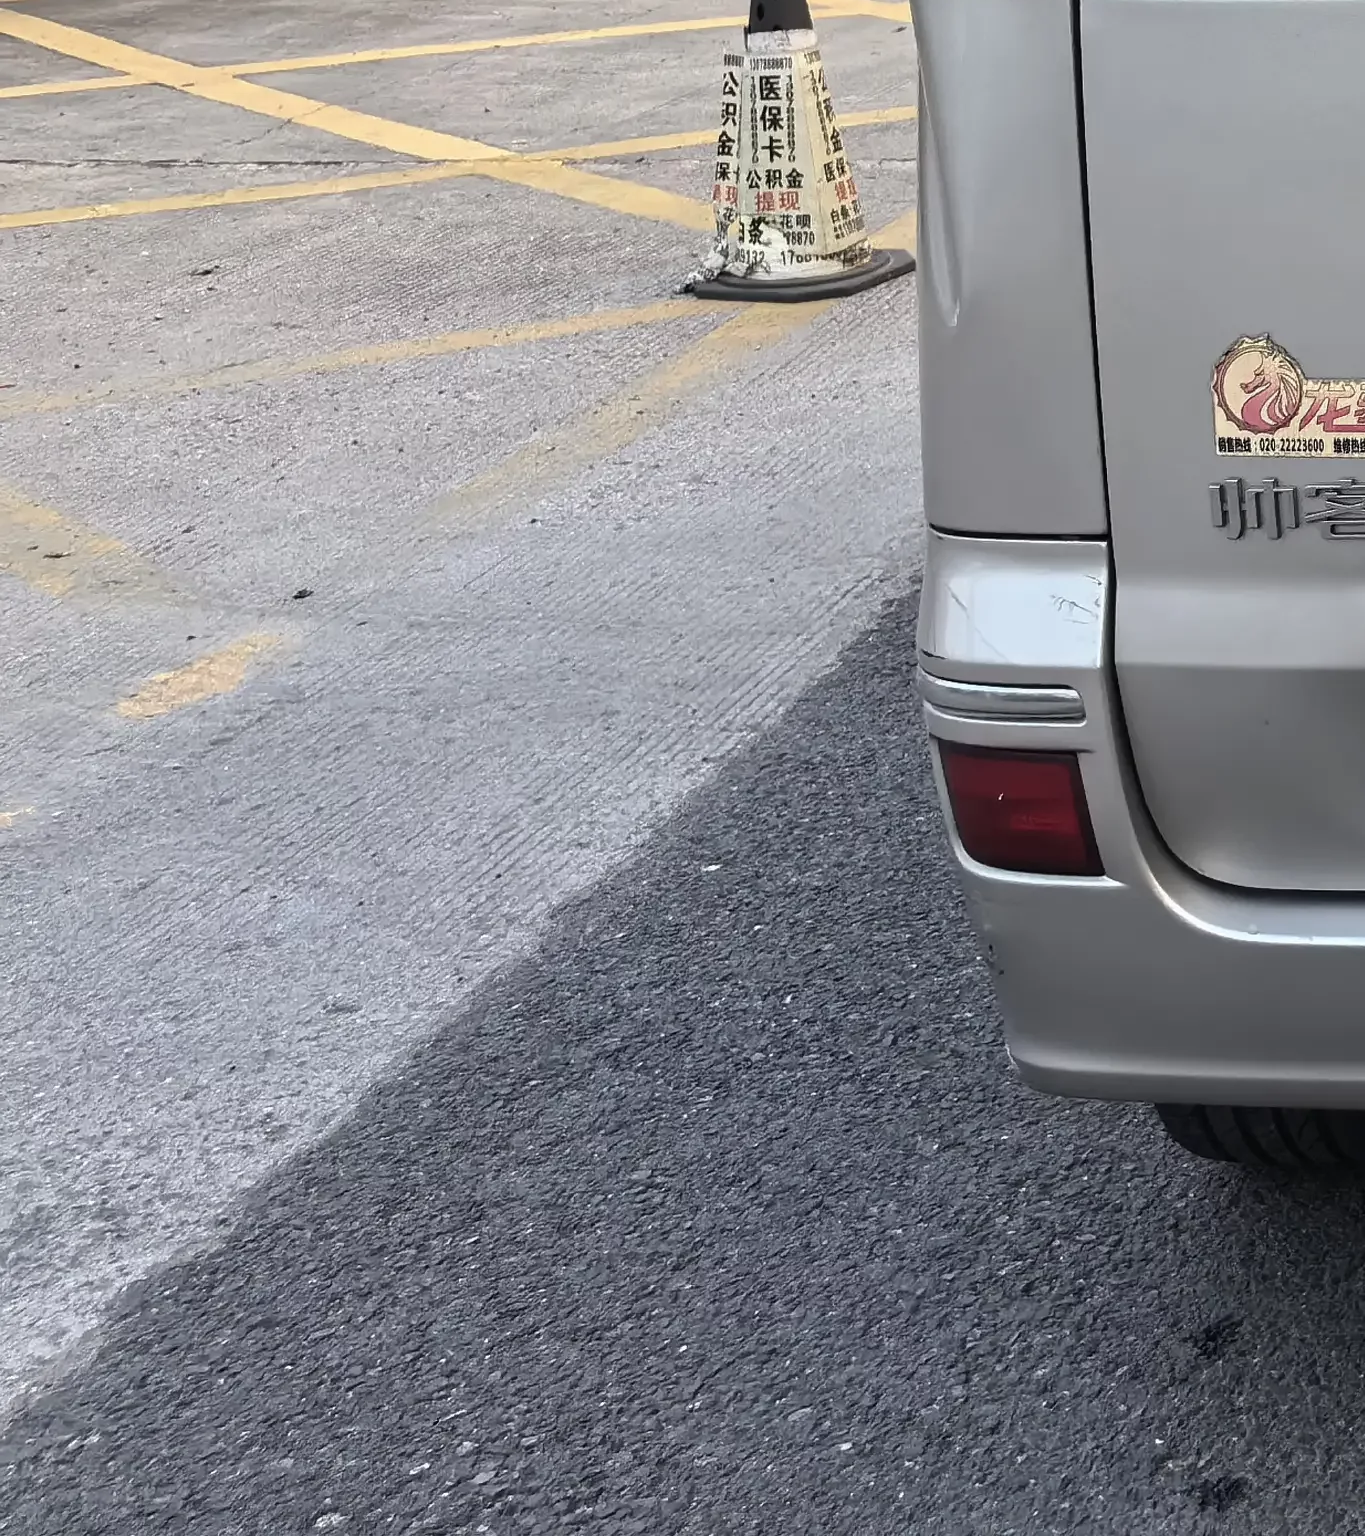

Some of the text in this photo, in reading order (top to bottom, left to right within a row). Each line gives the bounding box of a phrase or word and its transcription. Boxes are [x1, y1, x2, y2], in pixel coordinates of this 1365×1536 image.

[759, 74, 785, 163] 医保卡
[745, 167, 804, 190] 公积金
[755, 191, 800, 215] 提现
